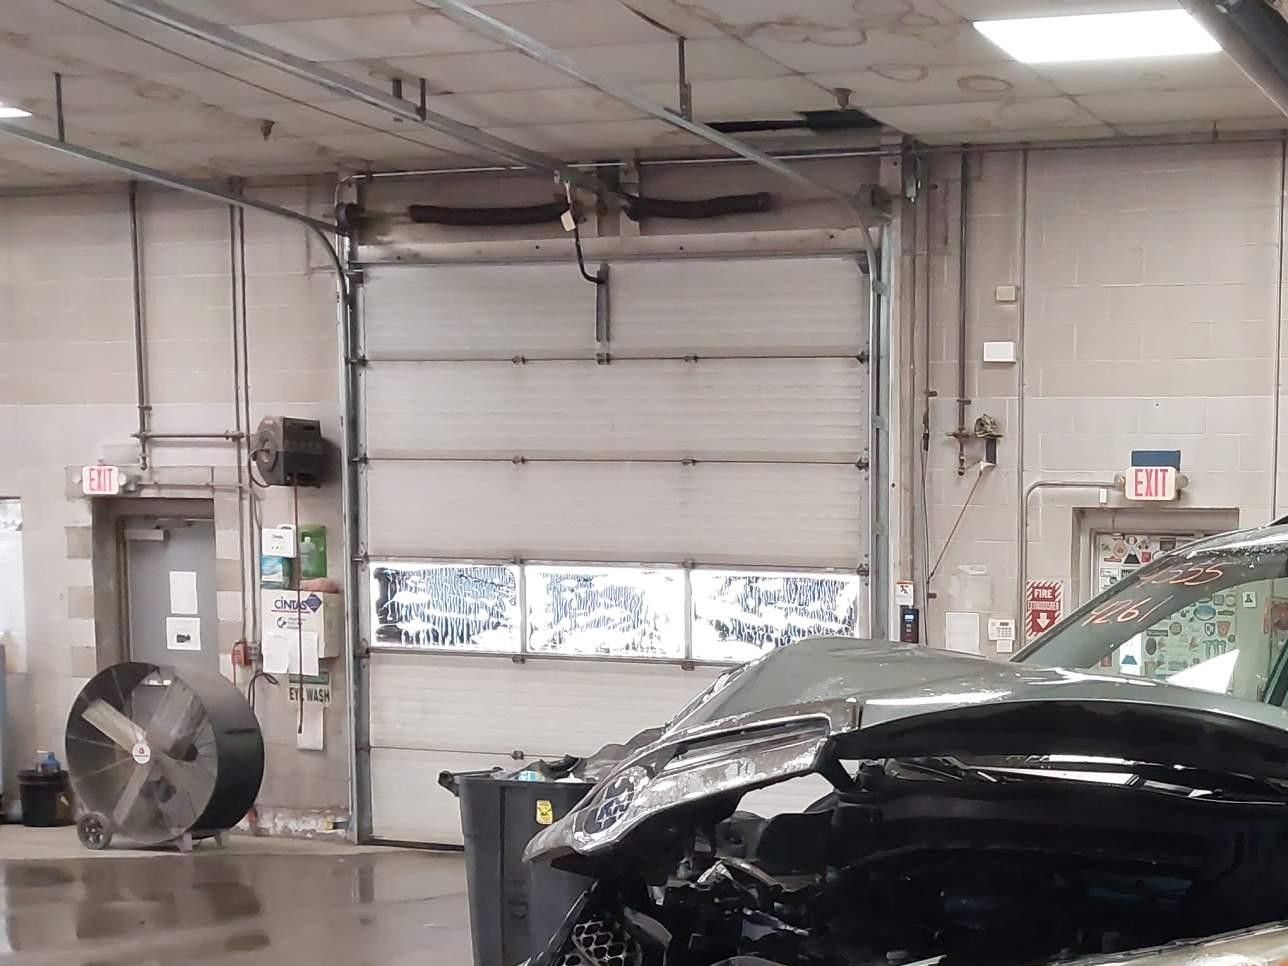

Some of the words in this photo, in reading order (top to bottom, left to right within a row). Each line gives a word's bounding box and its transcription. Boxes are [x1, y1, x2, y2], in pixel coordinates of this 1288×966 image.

[88, 467, 113, 492] EXIT
[1134, 468, 1169, 497] EXIT
[1034, 588, 1053, 599] FIRE
[306, 687, 330, 702] WASH
